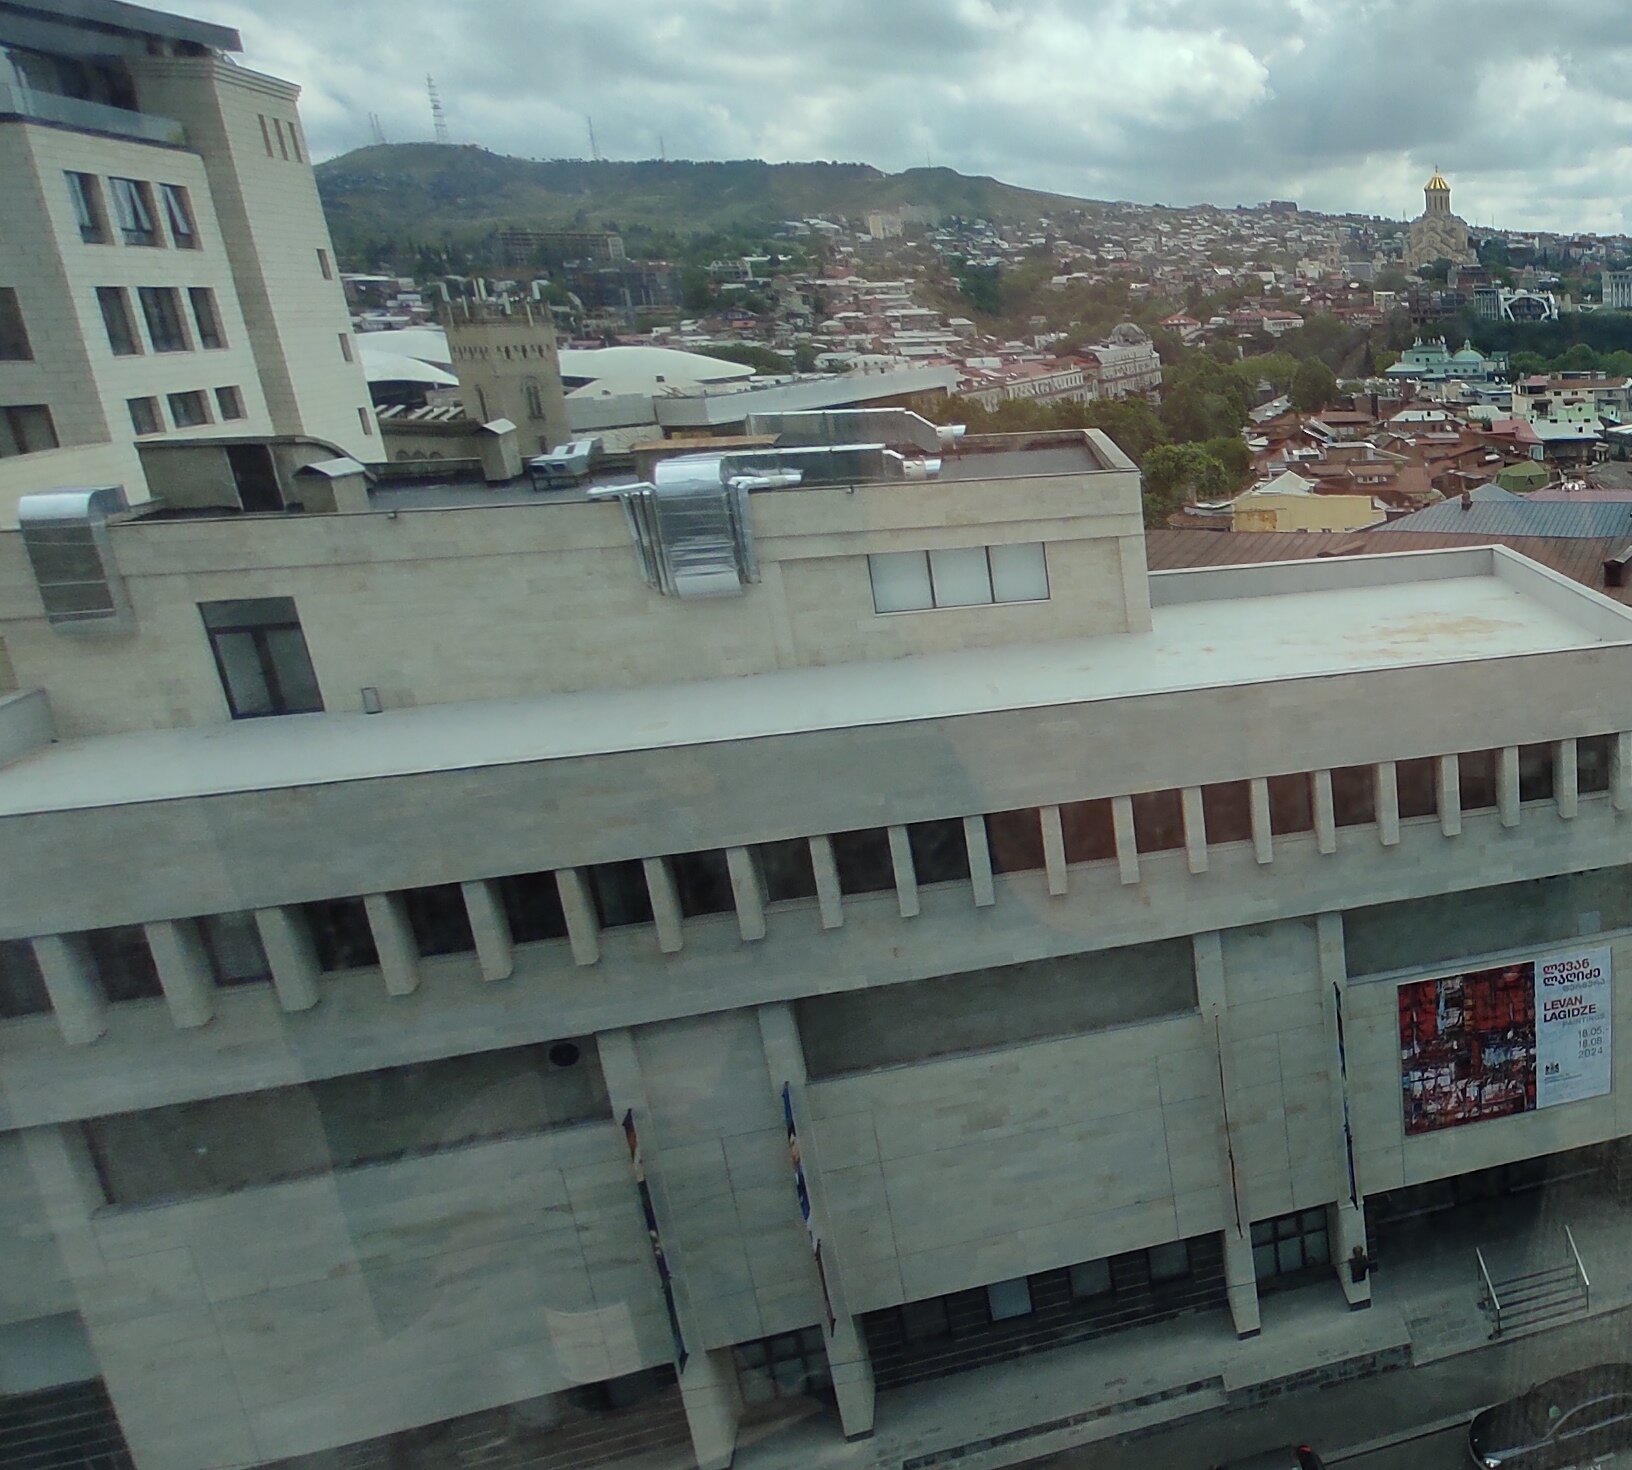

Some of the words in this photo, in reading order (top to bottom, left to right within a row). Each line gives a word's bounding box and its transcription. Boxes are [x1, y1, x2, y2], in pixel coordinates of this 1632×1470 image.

[1543, 958, 1590, 975] ლევან
[1543, 967, 1601, 987] ლაღიძე
[1543, 994, 1583, 1011] LEVAN
[1543, 1003, 1597, 1023] LAGIDZE
[1578, 1046, 1603, 1059] 2024
